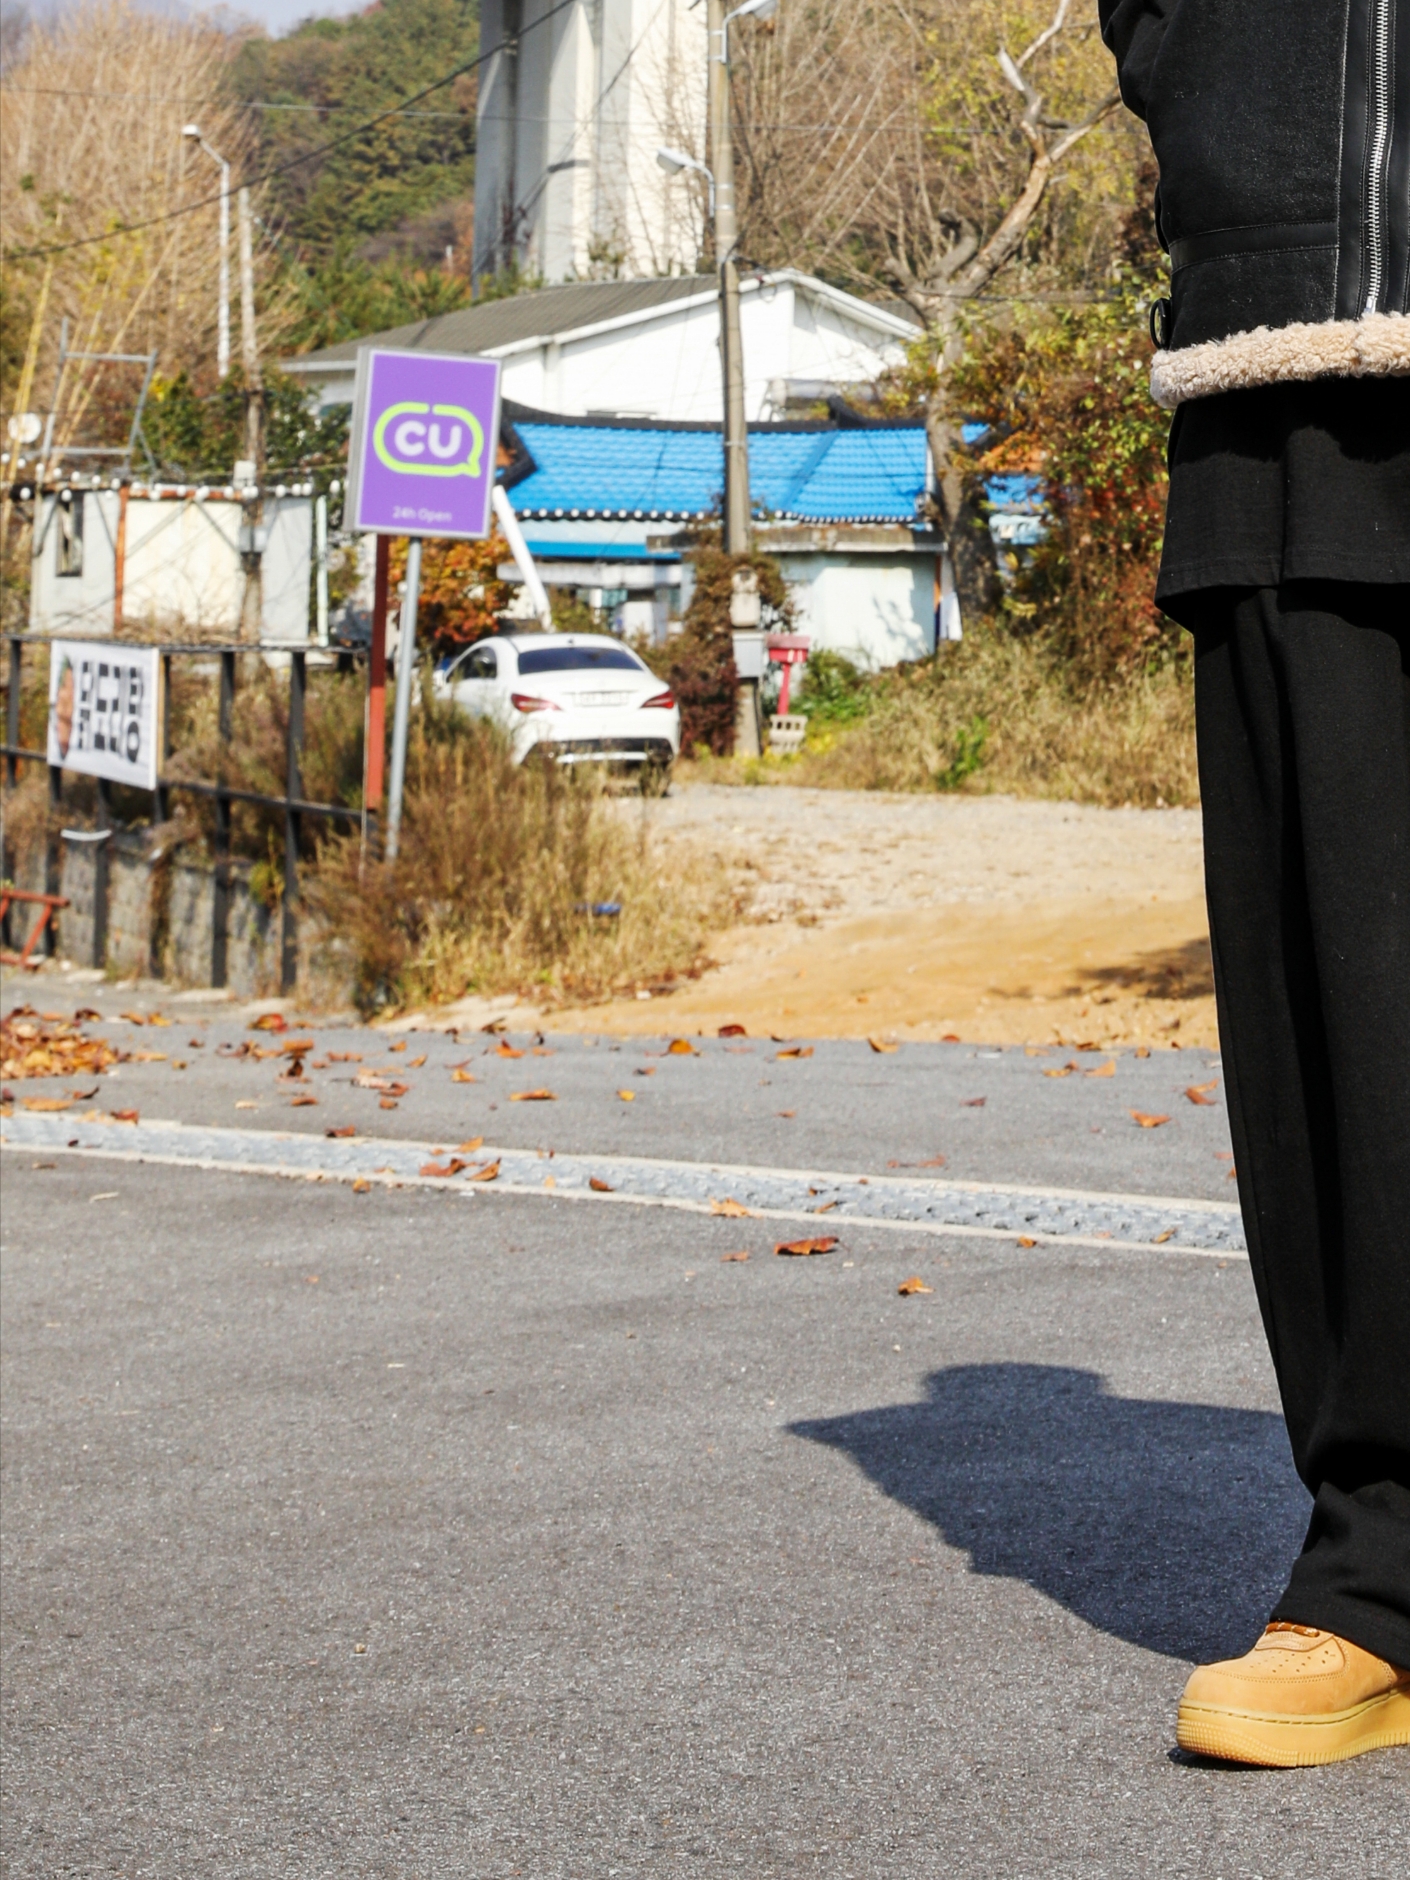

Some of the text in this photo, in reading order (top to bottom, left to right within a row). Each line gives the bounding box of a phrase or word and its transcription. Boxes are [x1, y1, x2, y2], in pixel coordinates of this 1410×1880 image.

[395, 420, 462, 458] CU
[392, 506, 453, 523] 24h Open
